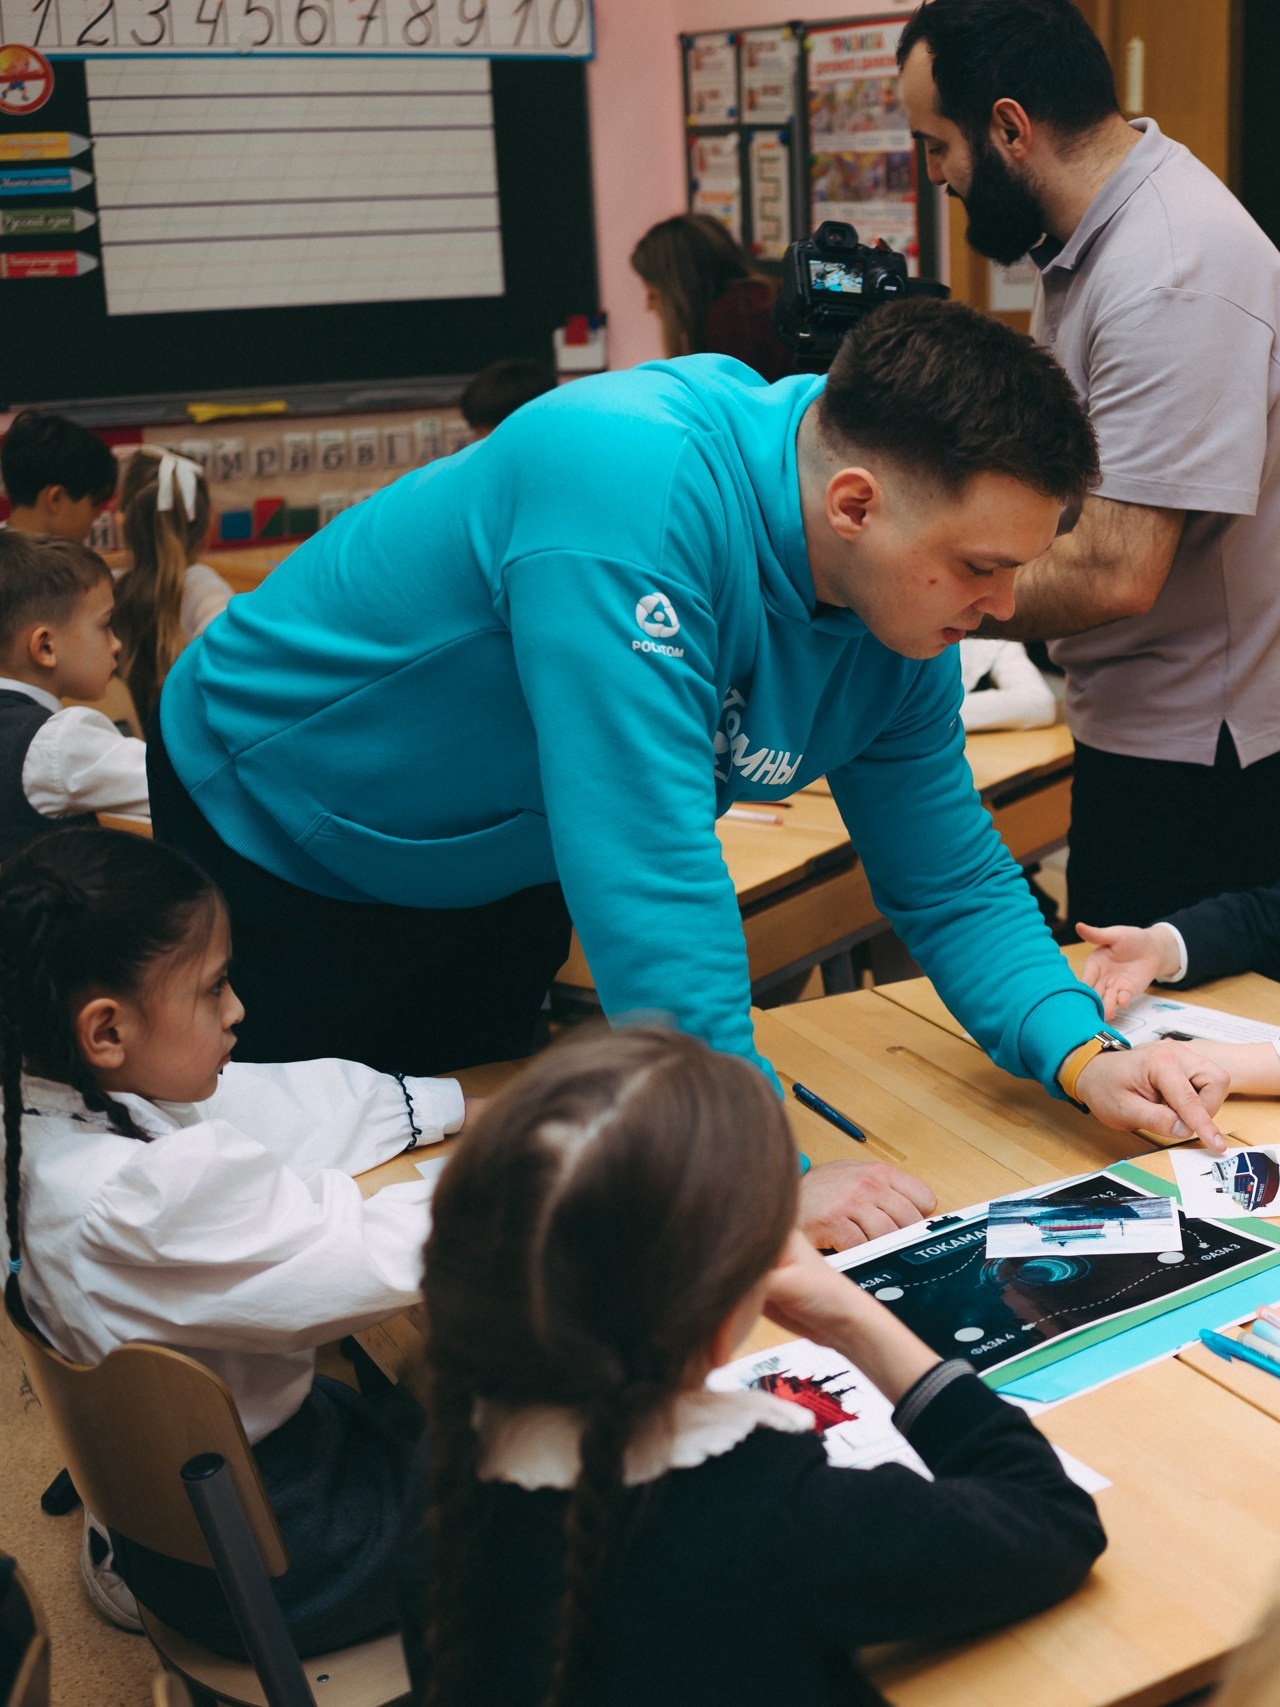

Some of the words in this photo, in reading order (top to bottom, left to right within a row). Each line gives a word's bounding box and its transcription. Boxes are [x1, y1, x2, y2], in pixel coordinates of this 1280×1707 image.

[31, 0, 50, 46] 1
[76, 0, 114, 46] 2
[130, 0, 170, 46] 3
[196, 0, 224, 46] 4
[246, 0, 274, 46] 5
[294, 0, 328, 46] 6
[402, 0, 435, 47] 8
[453, 0, 487, 47] 9
[512, 0, 584, 48] 10
[1200, 1246, 1234, 1261] ФАЗА
[859, 1276, 886, 1290] АЗА
[970, 1337, 1007, 1355] ФАЗА
[1004, 1332, 1015, 1340] 4
